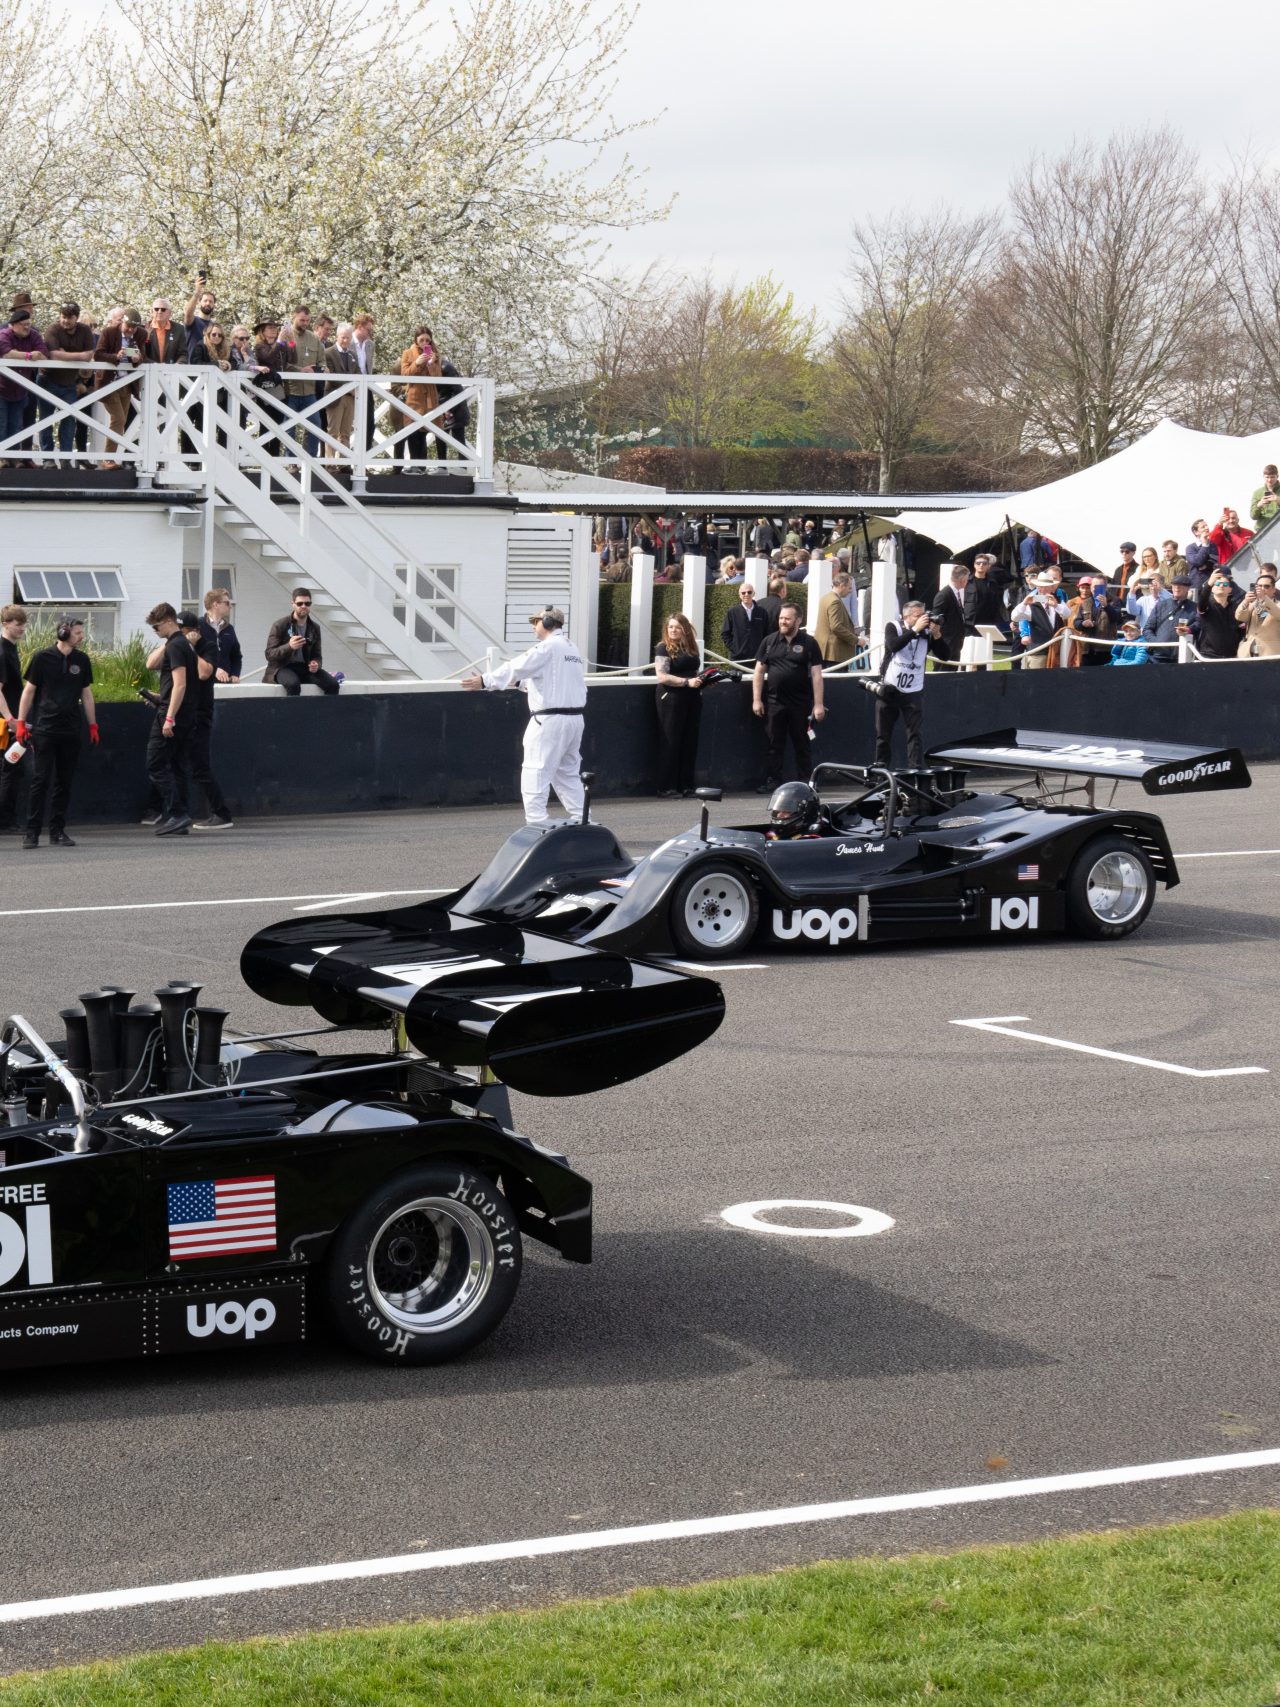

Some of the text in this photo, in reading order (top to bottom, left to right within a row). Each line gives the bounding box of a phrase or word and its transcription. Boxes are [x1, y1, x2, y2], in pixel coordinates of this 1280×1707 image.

[896, 672, 915, 689] 102
[1158, 760, 1231, 786] GOODYEAR
[835, 842, 884, 856] James Hunt
[990, 896, 1039, 931] 101
[449, 1173, 515, 1269] Hoosier
[347, 1264, 417, 1356] Hoosier
[26, 1324, 79, 1337] Company
